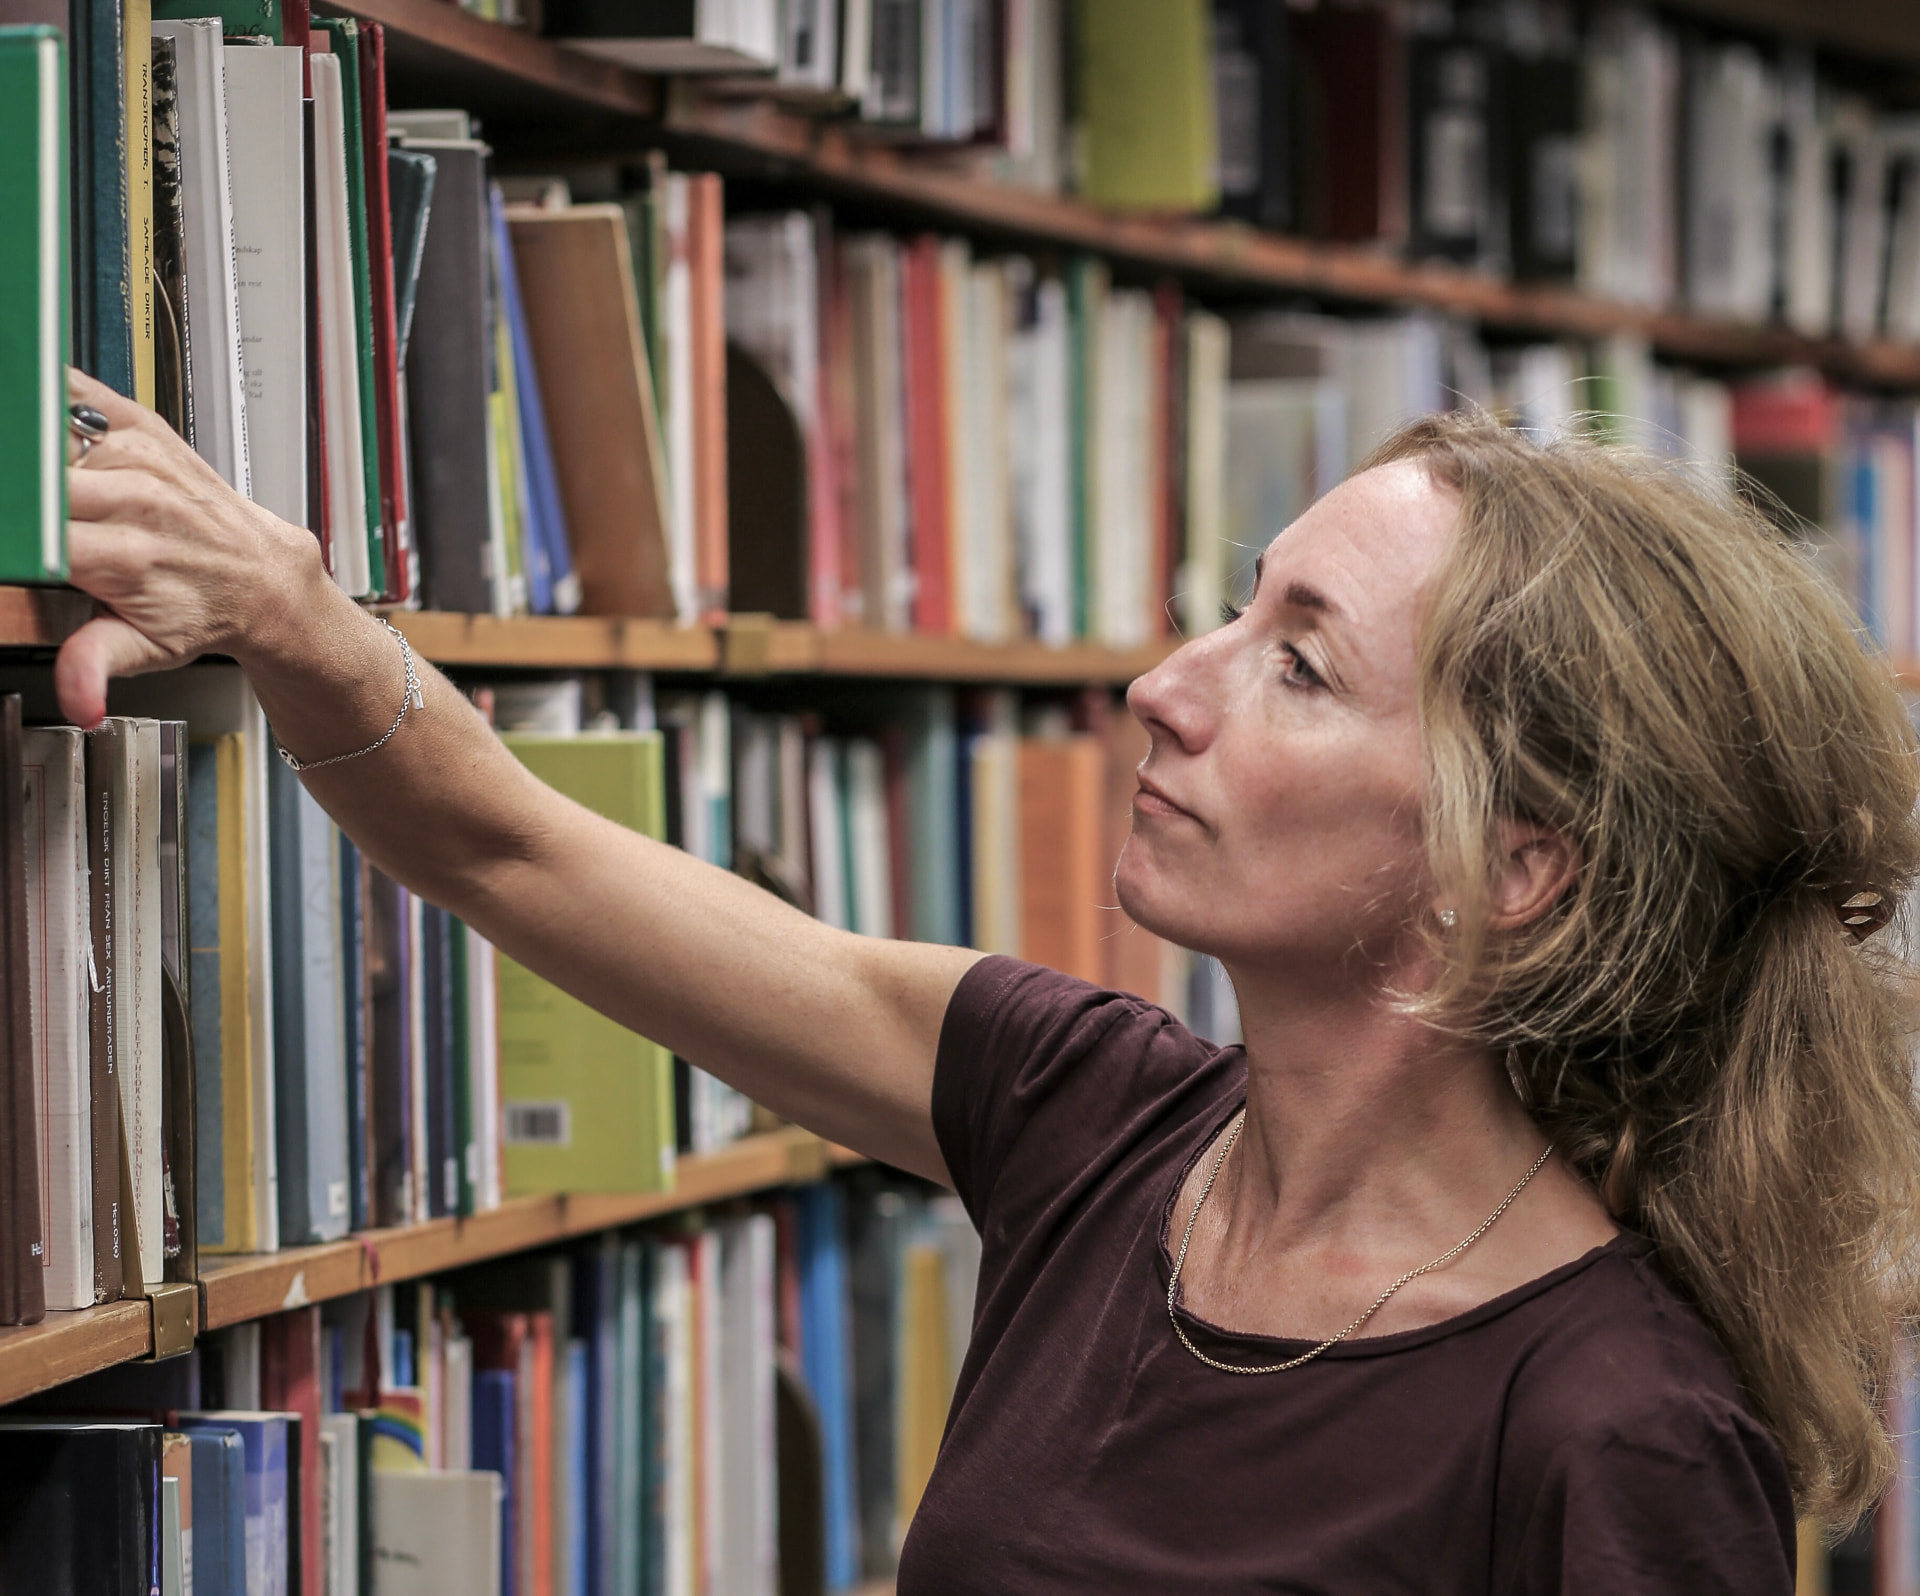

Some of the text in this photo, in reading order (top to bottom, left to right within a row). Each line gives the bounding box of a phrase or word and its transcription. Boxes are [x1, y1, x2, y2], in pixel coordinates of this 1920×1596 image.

[144, 291, 152, 339] DIKTER
[102, 790, 110, 853] ENGELSK
[103, 857, 111, 886] DIKT
